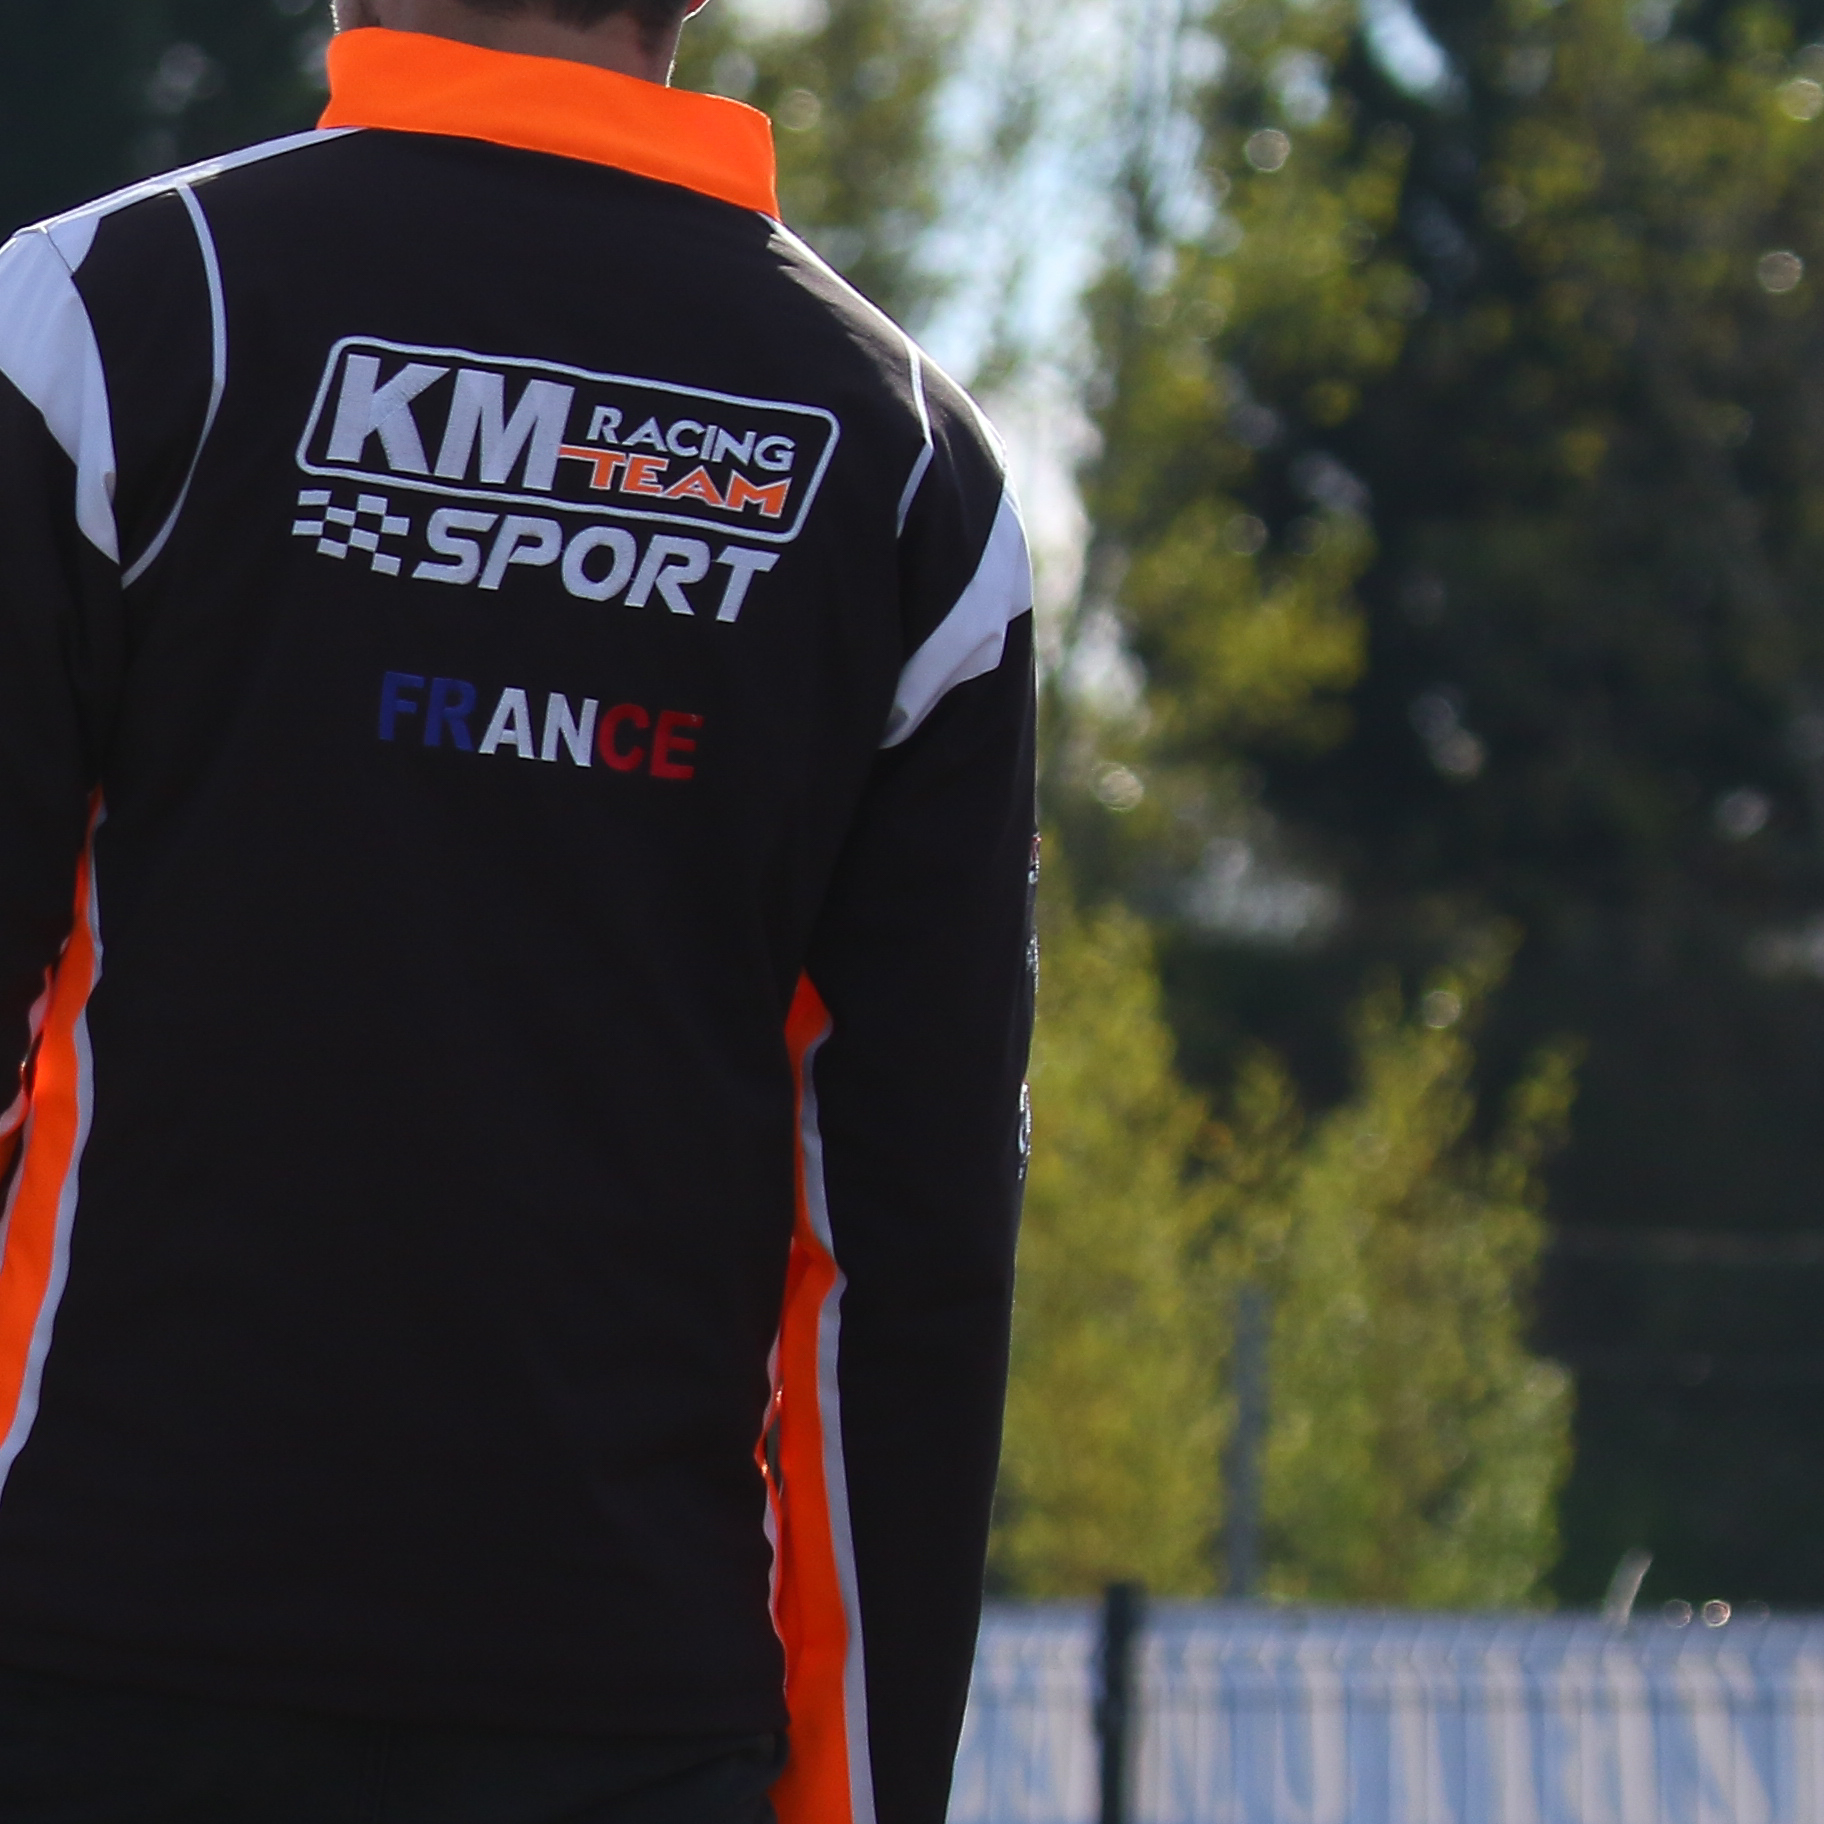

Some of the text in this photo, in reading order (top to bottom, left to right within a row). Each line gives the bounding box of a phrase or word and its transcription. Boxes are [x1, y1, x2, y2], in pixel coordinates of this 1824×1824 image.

[325, 354, 575, 491] KM
[586, 405, 796, 472] RACING
[557, 444, 793, 519] TEAM
[412, 507, 780, 623] SPORT
[378, 670, 705, 781] FRANCE
